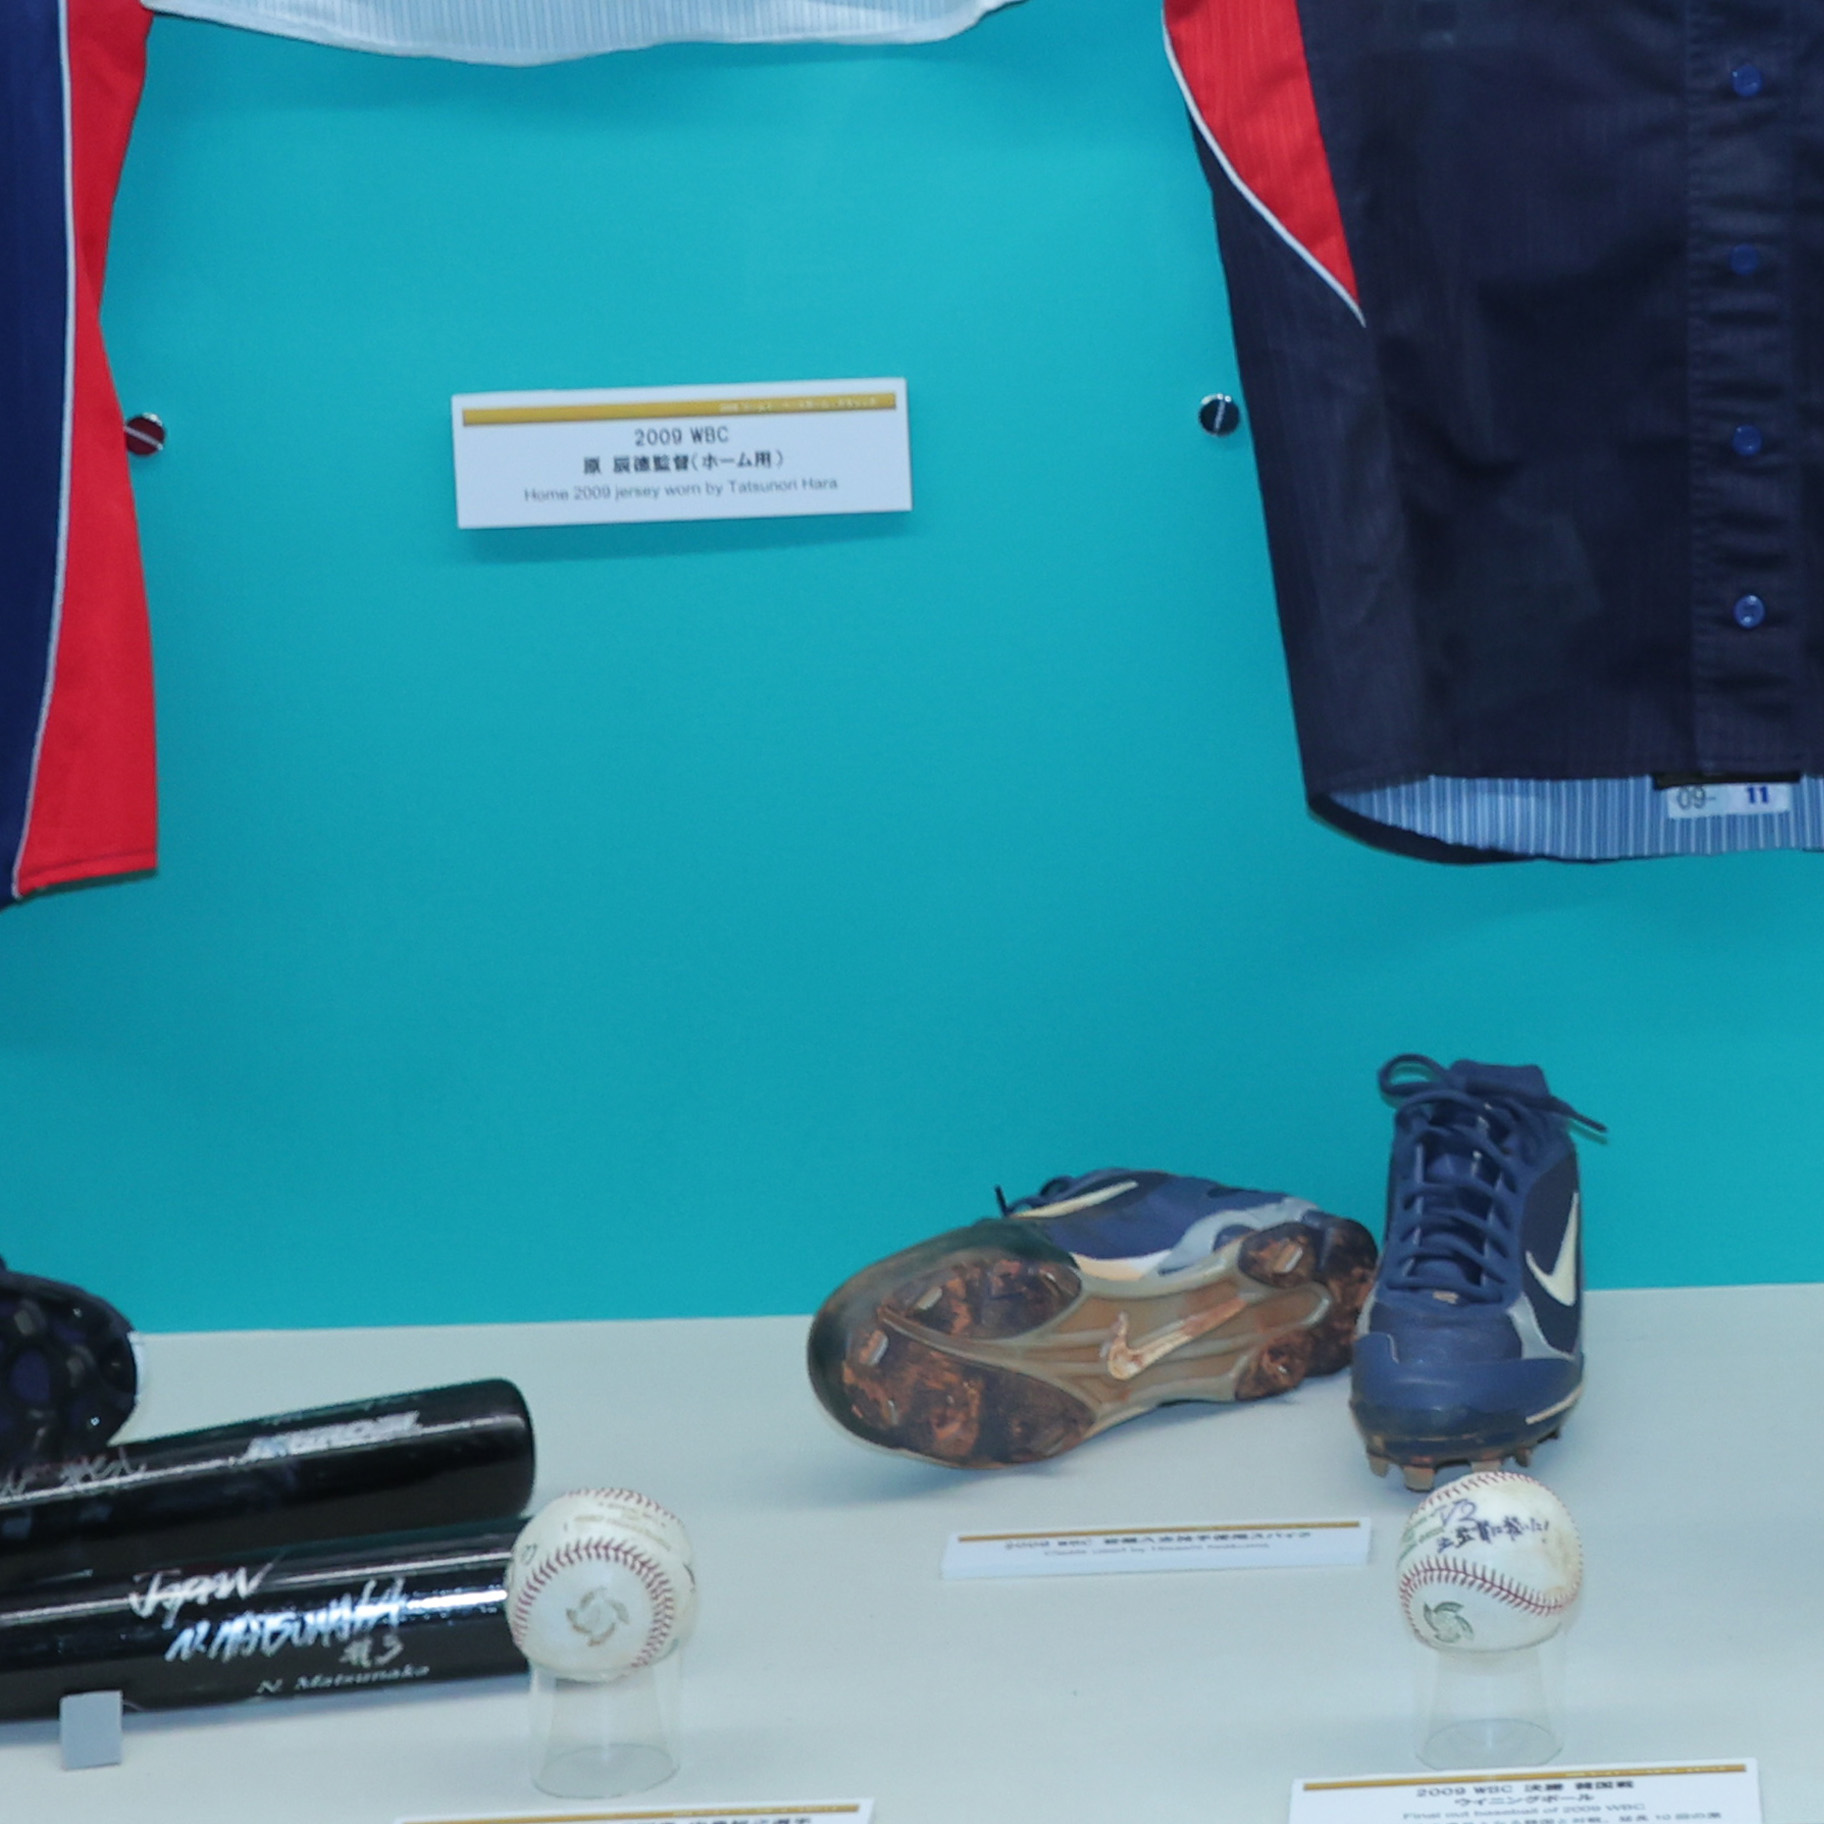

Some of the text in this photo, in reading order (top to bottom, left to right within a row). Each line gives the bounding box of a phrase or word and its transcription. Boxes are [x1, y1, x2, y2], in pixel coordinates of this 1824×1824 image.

[634, 426, 730, 447] 2009 WBC
[524, 487, 569, 502] Home
[574, 485, 612, 501] 2009
[614, 484, 660, 504] jersey
[705, 481, 723, 498] by
[801, 477, 839, 492] Hara
[1746, 785, 1770, 805] 11
[1416, 1786, 1467, 1798] 2009
[1473, 1784, 1514, 1795] WBC
